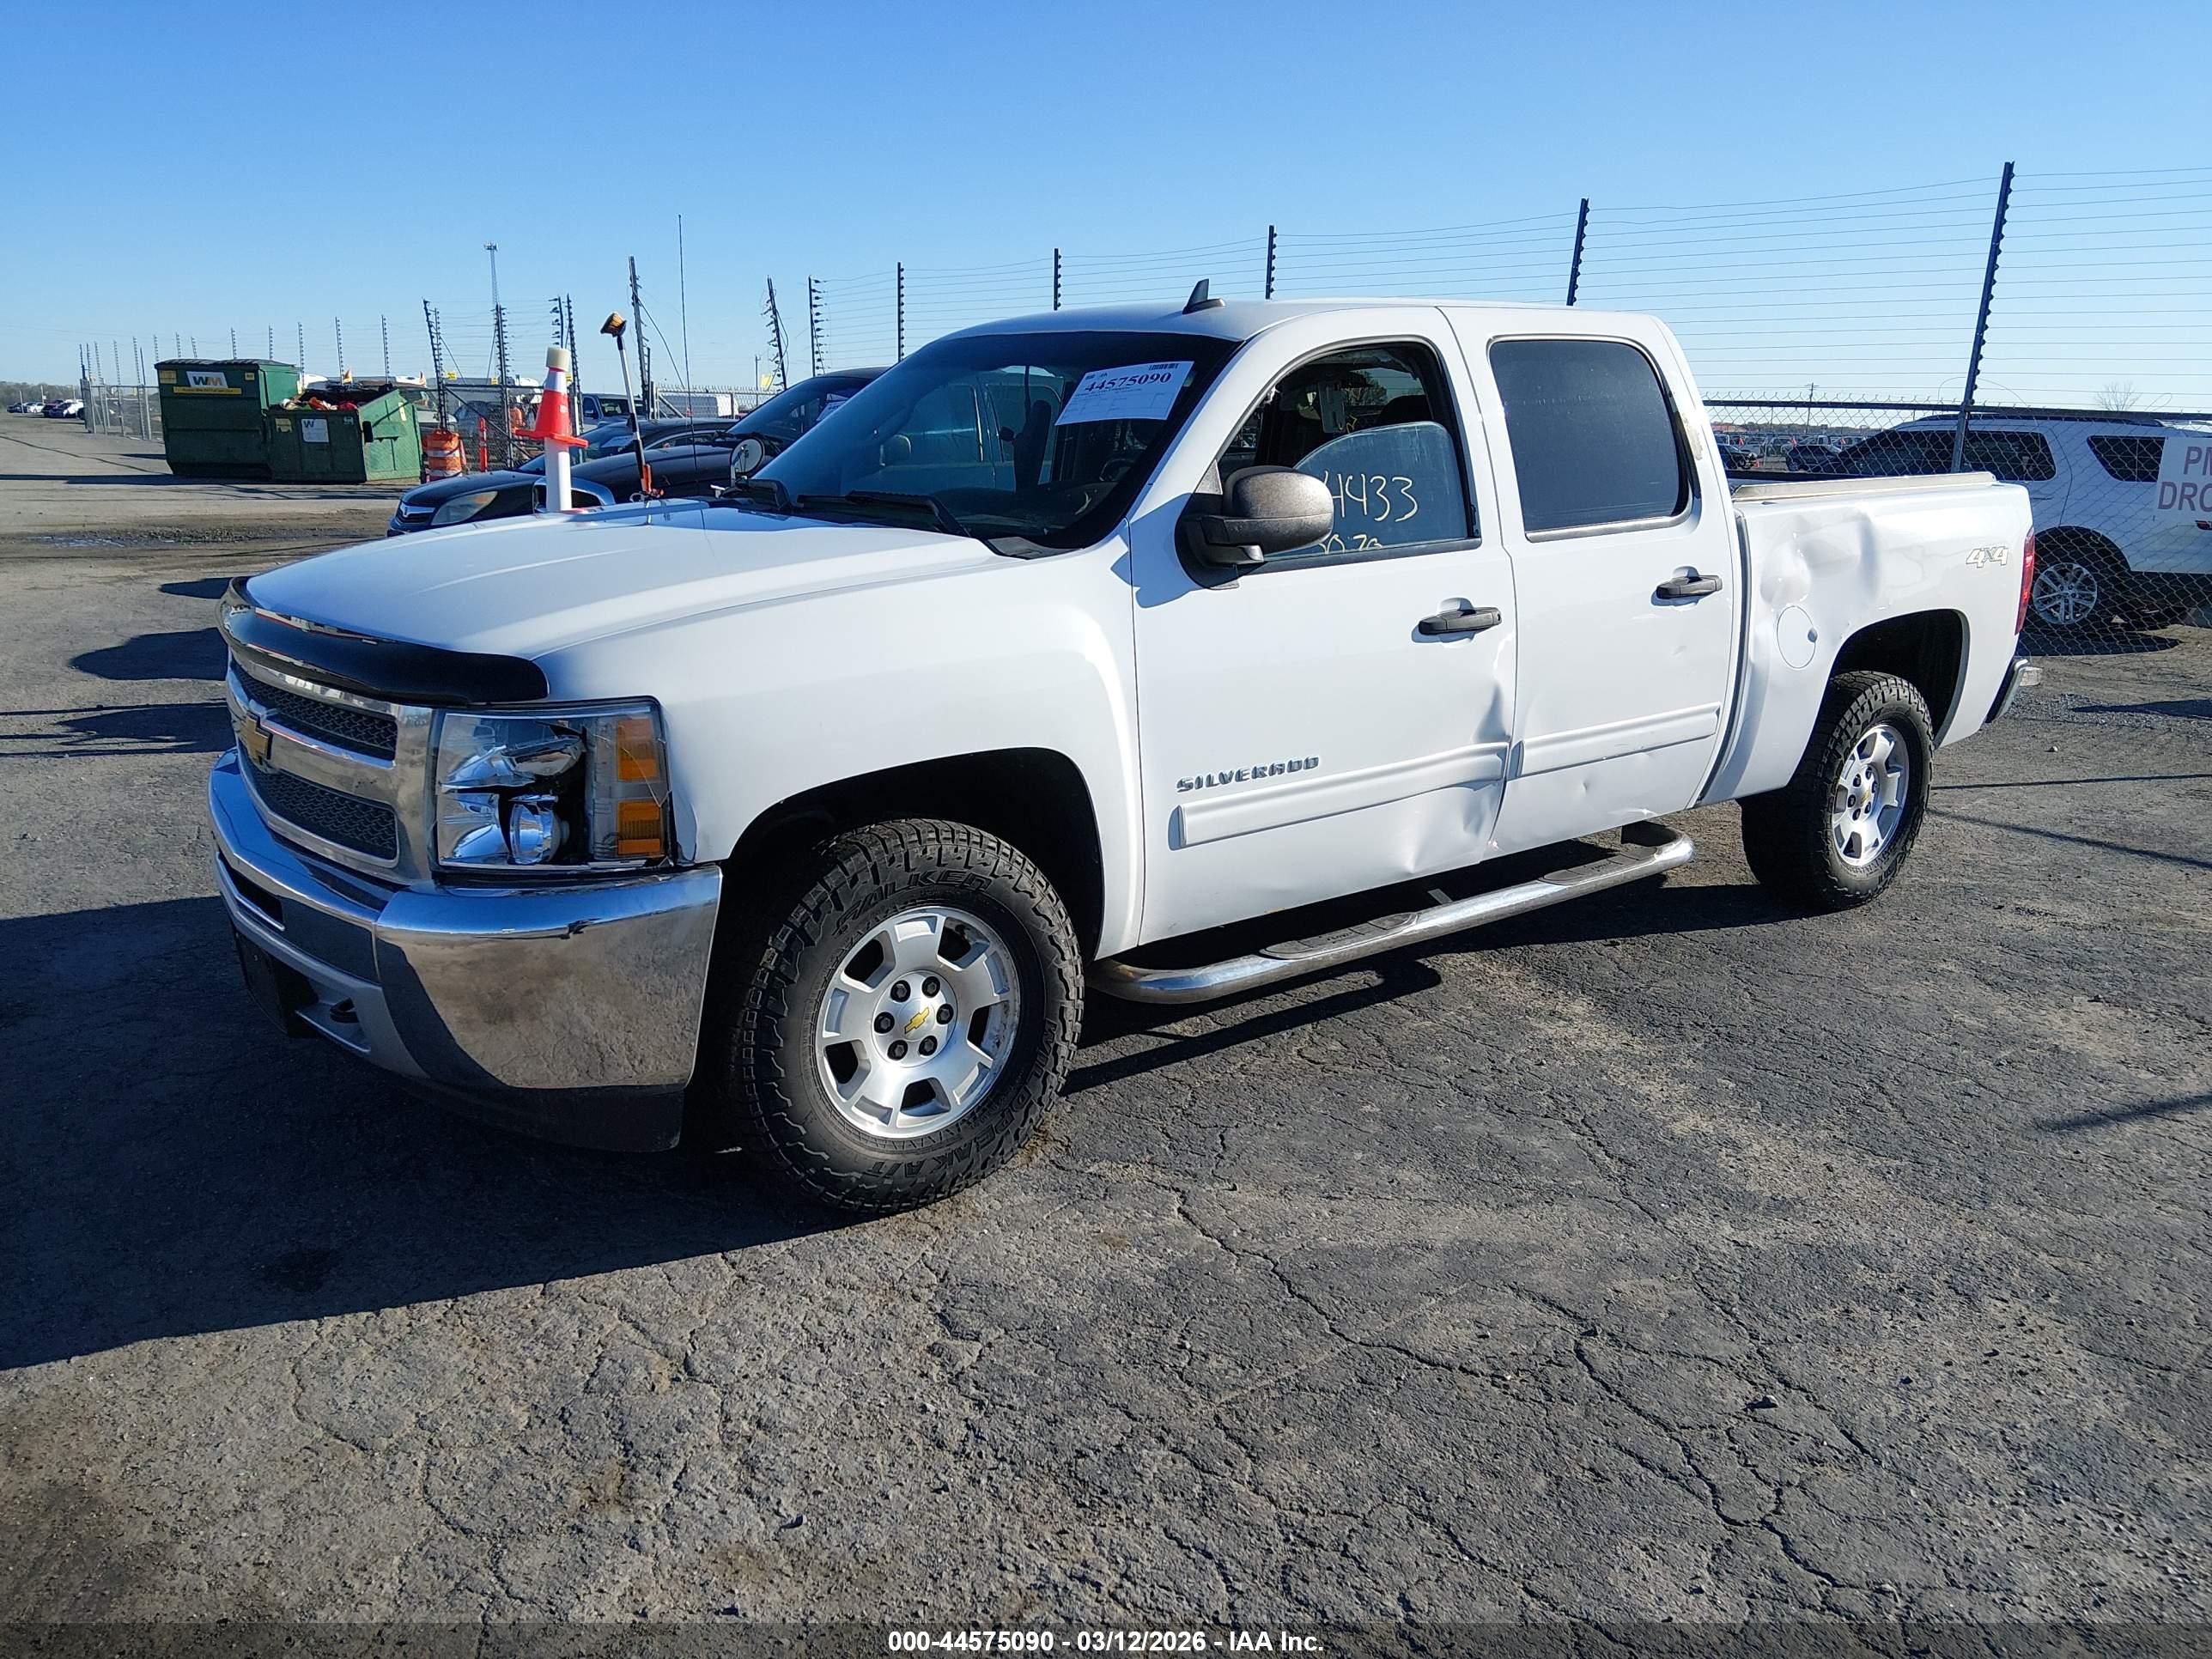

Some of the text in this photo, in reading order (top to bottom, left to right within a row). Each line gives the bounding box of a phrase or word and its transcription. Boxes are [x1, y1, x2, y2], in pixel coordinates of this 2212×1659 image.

[192, 376, 223, 386] WM
[1085, 372, 1172, 392] 44575090
[1176, 756, 1320, 793] SILVERADO
